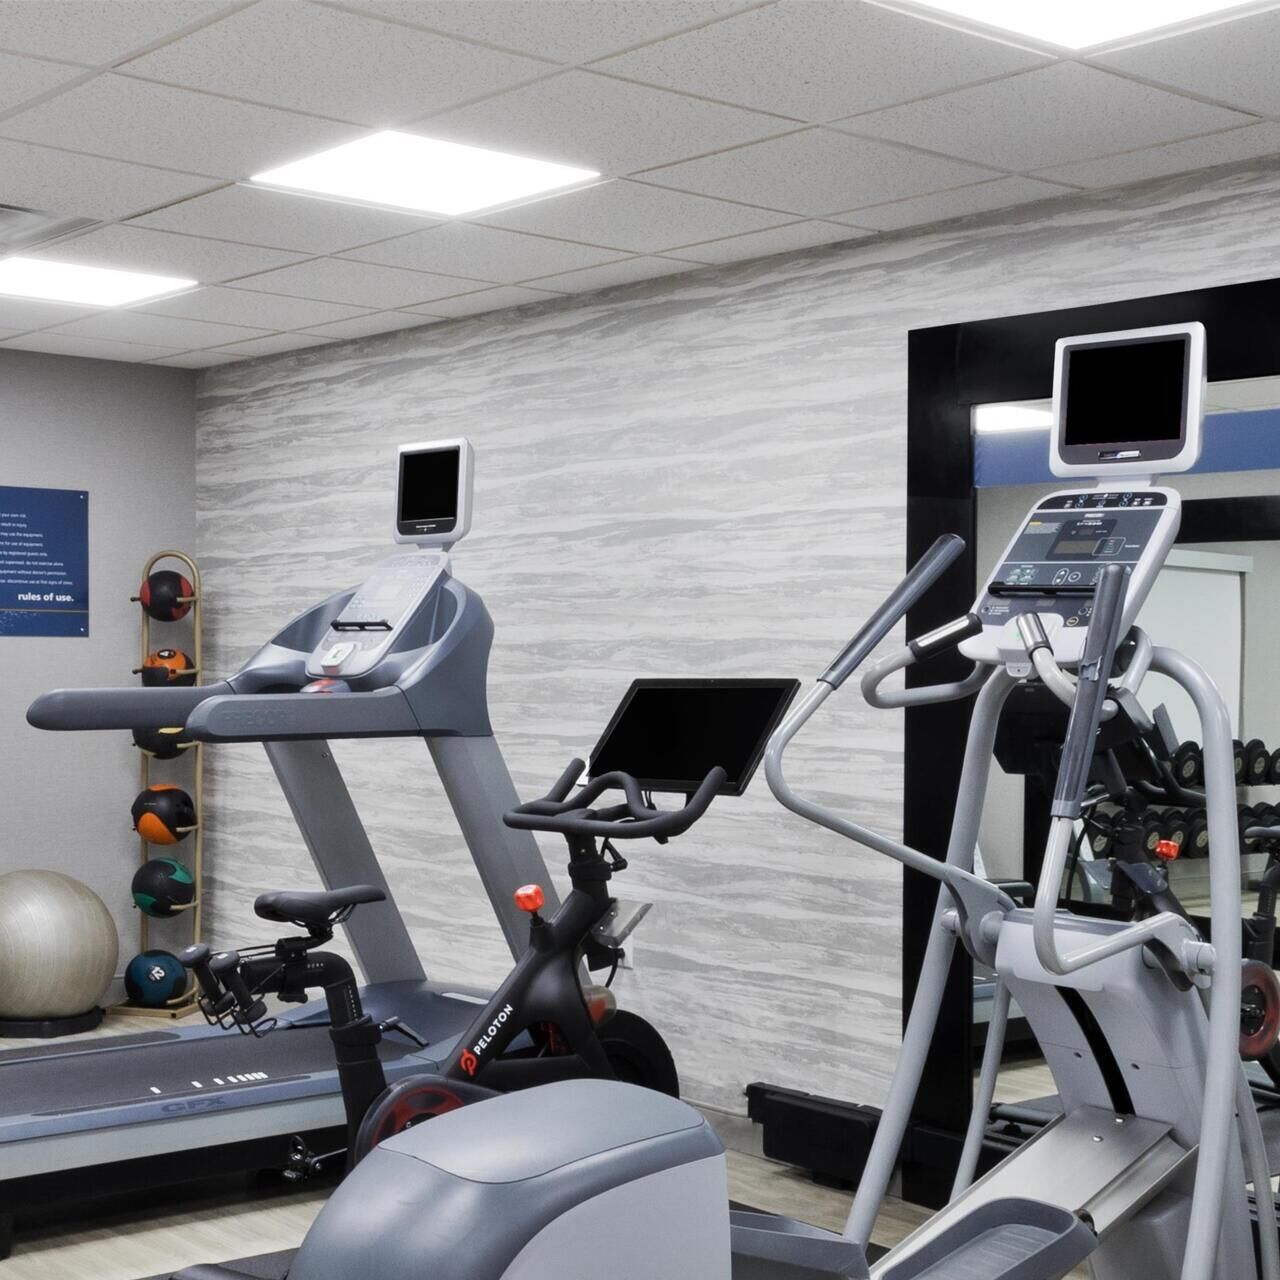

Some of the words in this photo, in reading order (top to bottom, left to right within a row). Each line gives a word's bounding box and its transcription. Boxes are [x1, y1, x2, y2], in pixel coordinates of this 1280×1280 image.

[18, 592, 41, 601] rules
[43, 592, 54, 601] of
[55, 594, 74, 602] use.
[150, 965, 165, 981] 12
[473, 1004, 514, 1055] PELOTON
